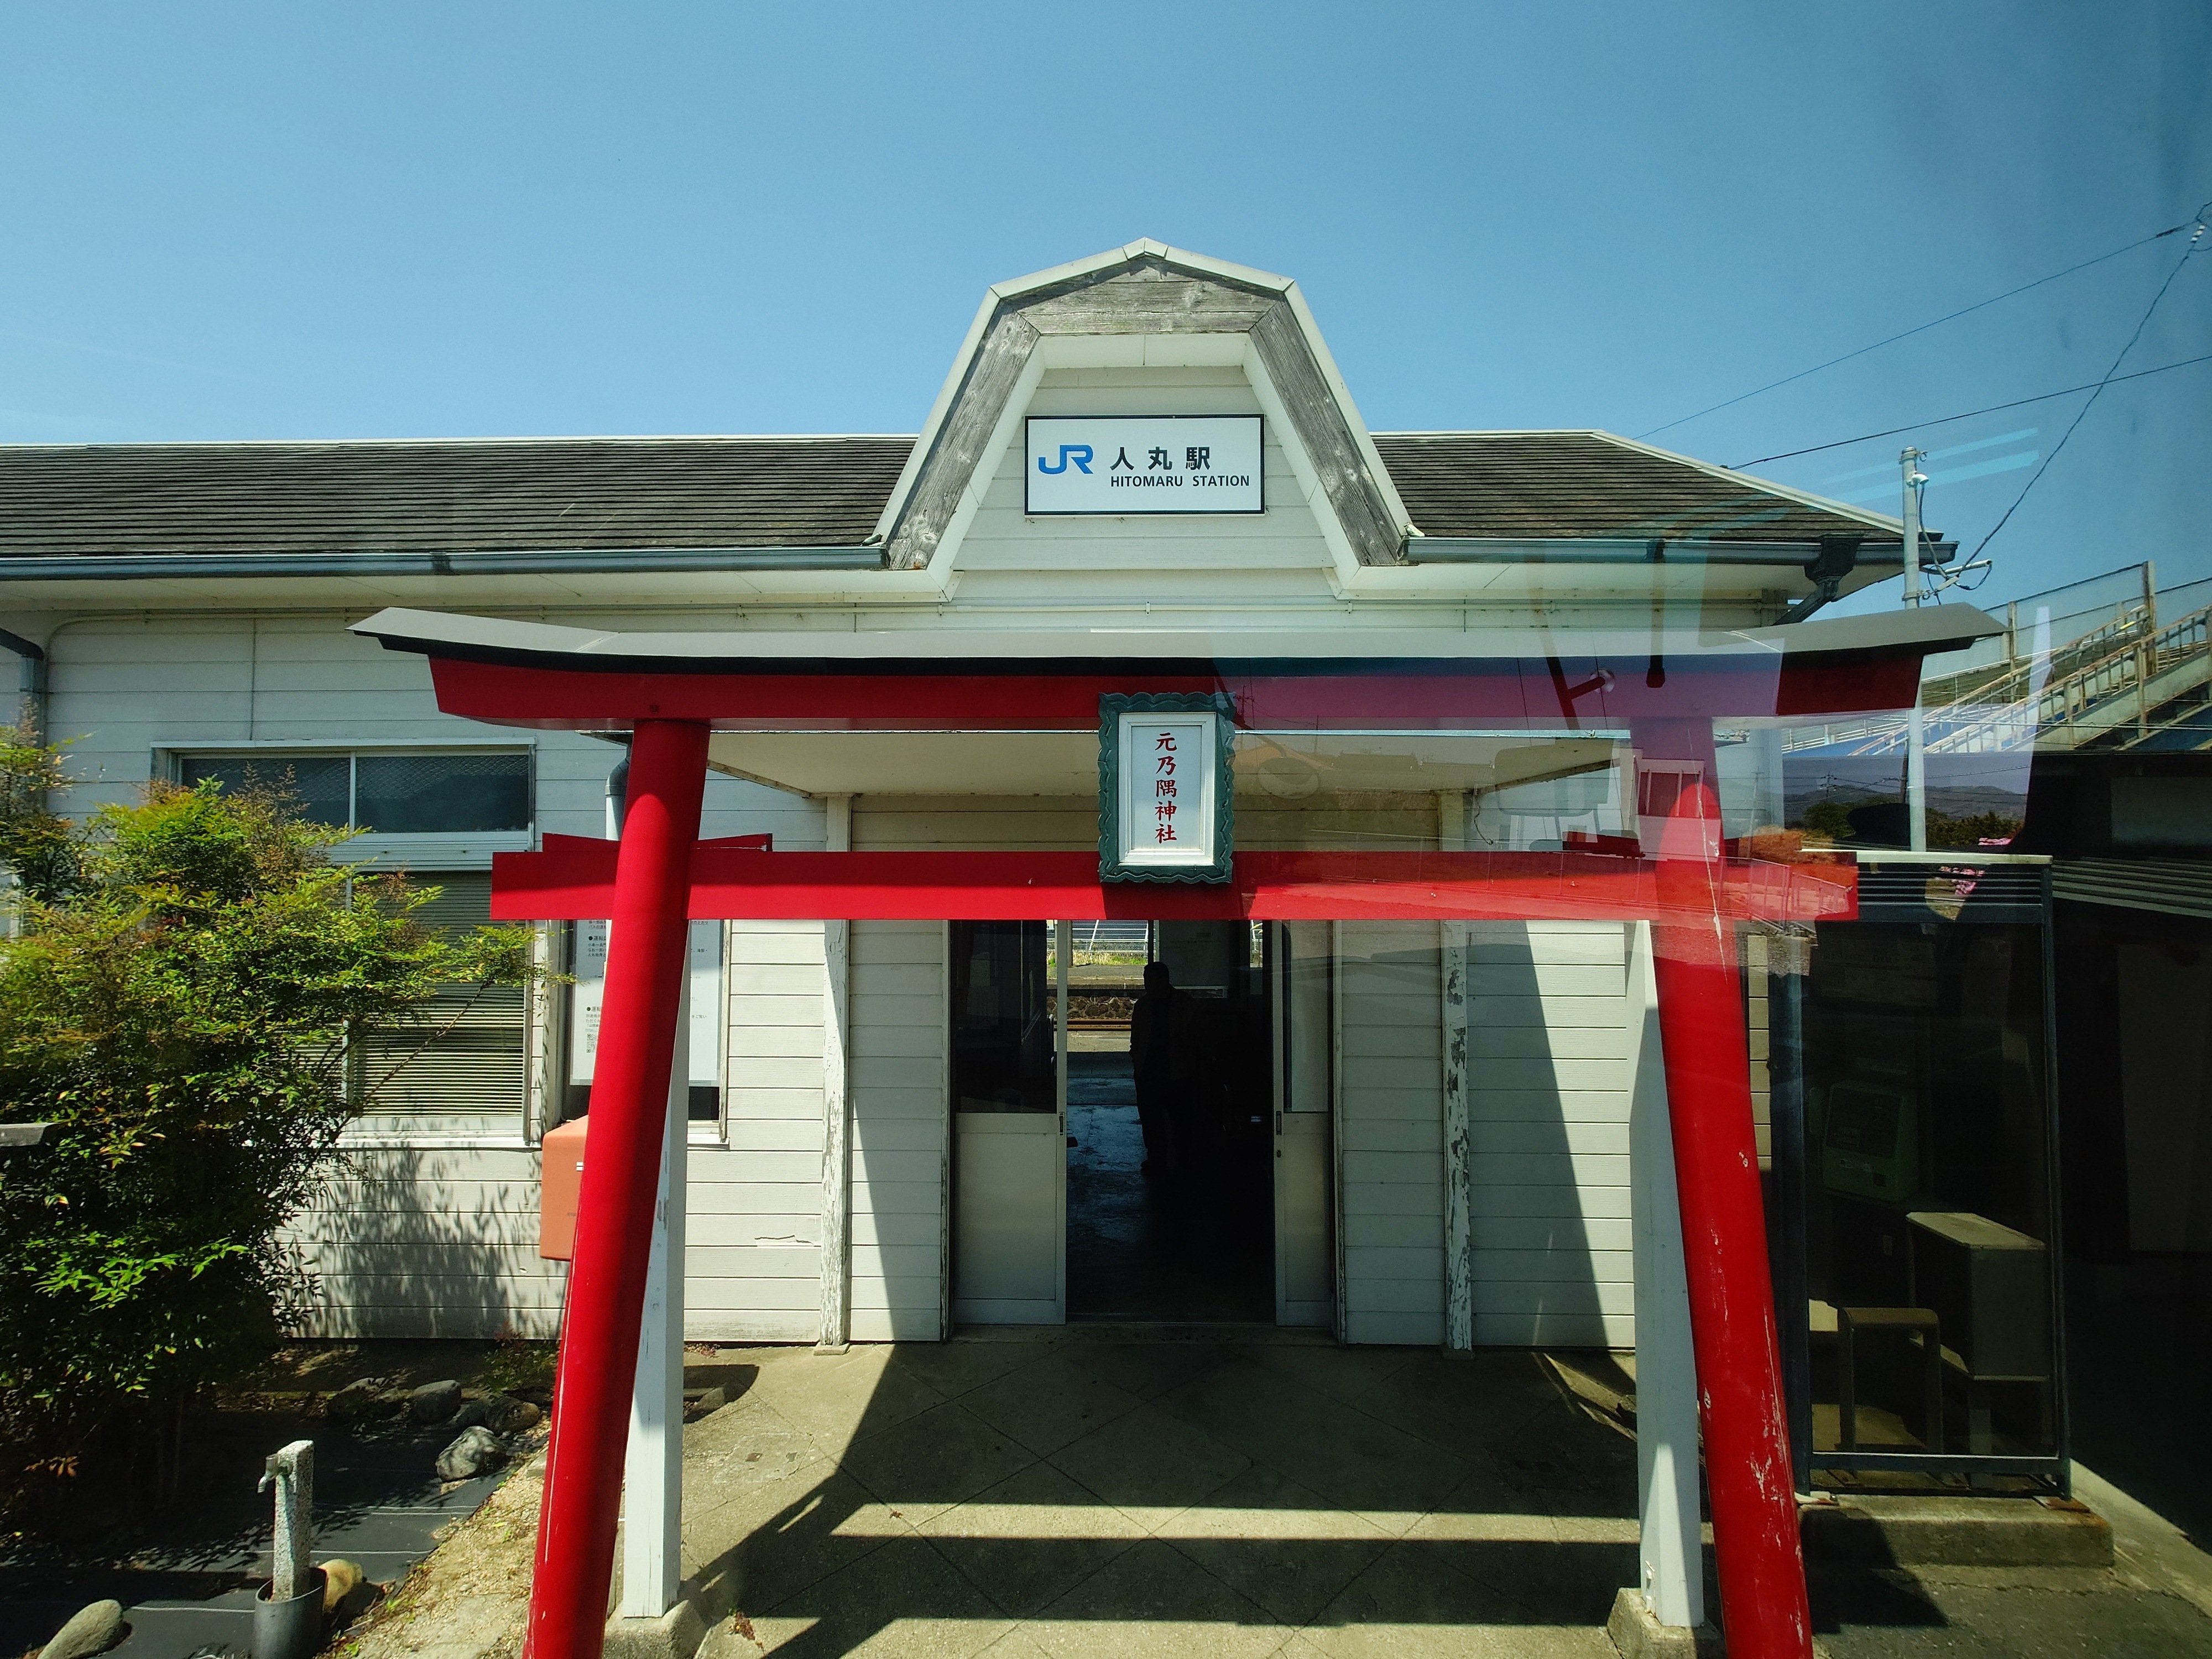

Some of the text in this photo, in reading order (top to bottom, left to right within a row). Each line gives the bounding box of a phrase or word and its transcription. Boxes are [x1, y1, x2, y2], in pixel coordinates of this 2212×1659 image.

[1038, 445, 1093, 474] JR
[1110, 447, 1211, 471] 人丸駅
[1110, 475, 1250, 487] HITOMARU STATION
[1154, 732, 1177, 844] 元乃隅神社
